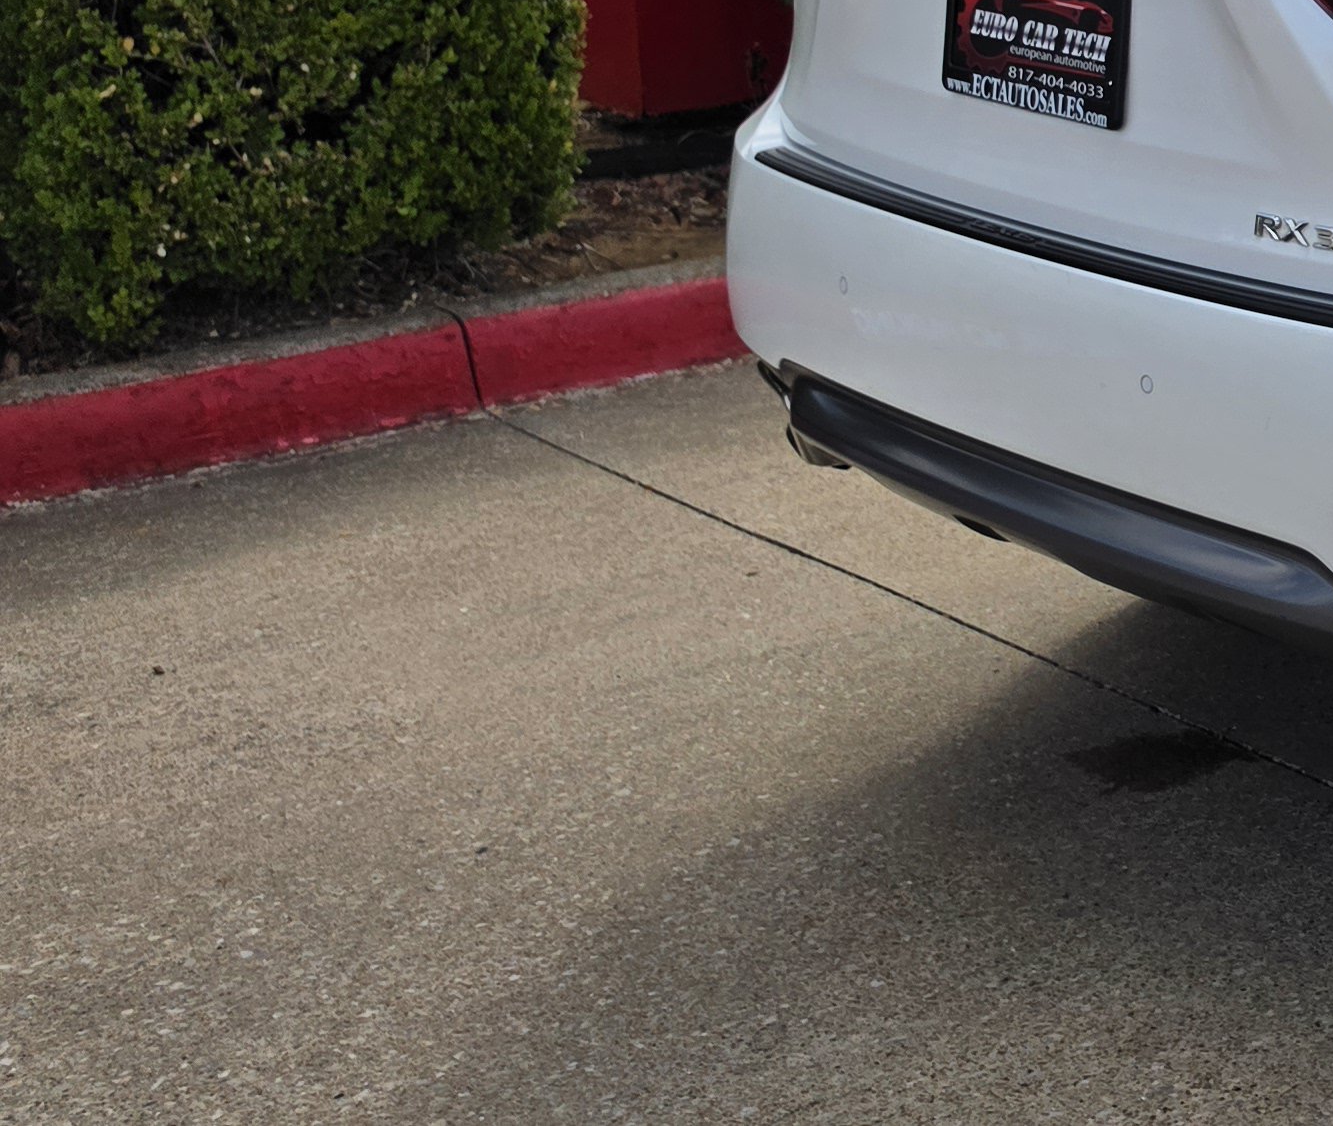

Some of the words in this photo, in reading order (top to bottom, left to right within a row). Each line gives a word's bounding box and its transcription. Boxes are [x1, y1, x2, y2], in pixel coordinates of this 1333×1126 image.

[970, 8, 1019, 43] EURO
[1022, 19, 1059, 52] CAR
[1063, 27, 1112, 63] TECH
[1009, 45, 1053, 62] european
[1053, 55, 1106, 74] automotive
[1008, 65, 1104, 99] 817-404-4033
[947, 73, 1107, 128] www.ECTAUTOSALES.com
[1254, 212, 1309, 247] RX
